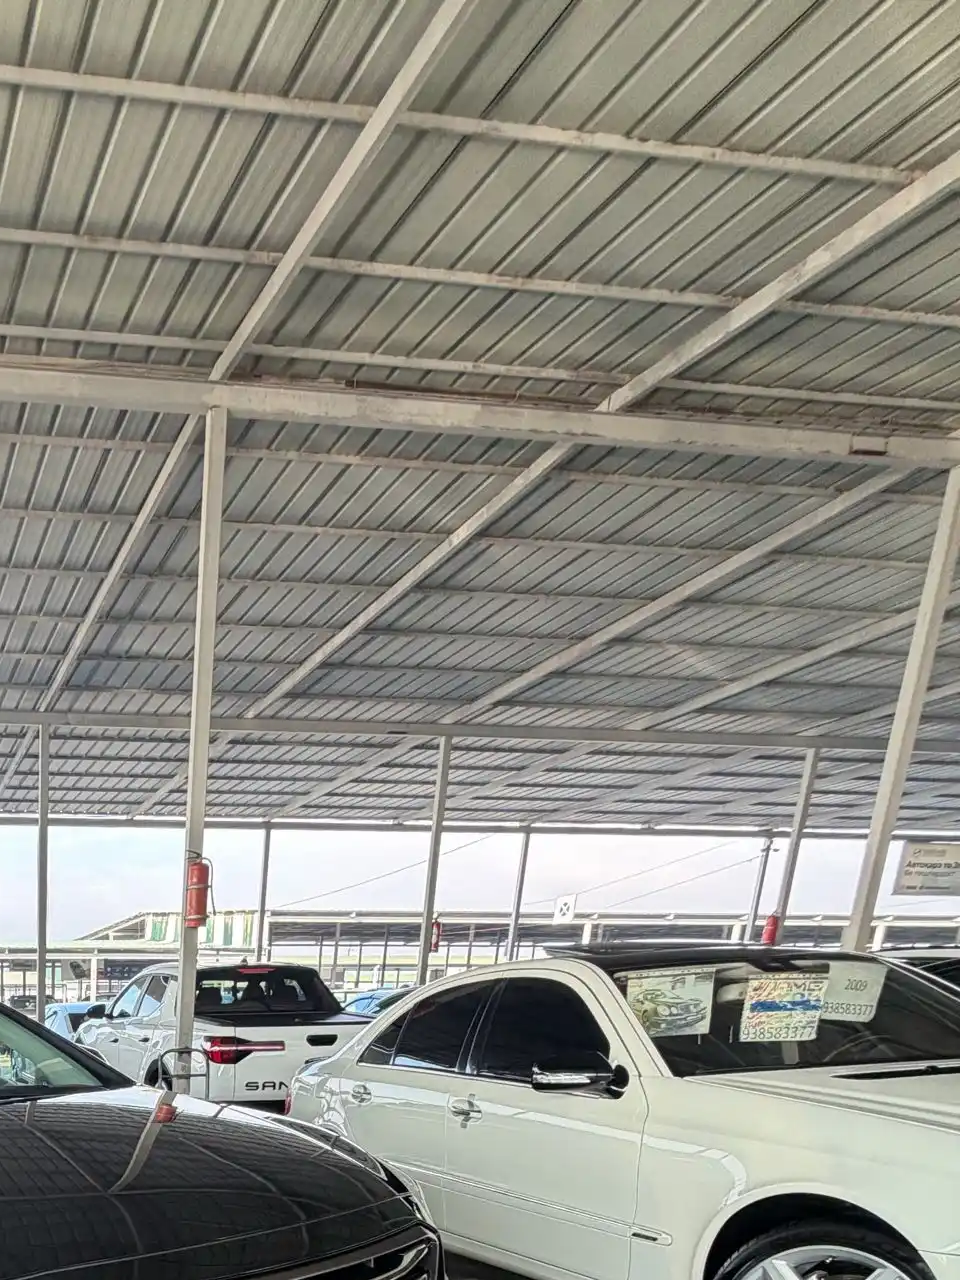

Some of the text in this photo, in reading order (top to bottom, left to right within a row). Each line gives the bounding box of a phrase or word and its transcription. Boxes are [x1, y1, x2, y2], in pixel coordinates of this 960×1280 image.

[844, 979, 868, 992] 2009
[823, 1001, 874, 1016] 938583377
[742, 1026, 816, 1040] 938583377
